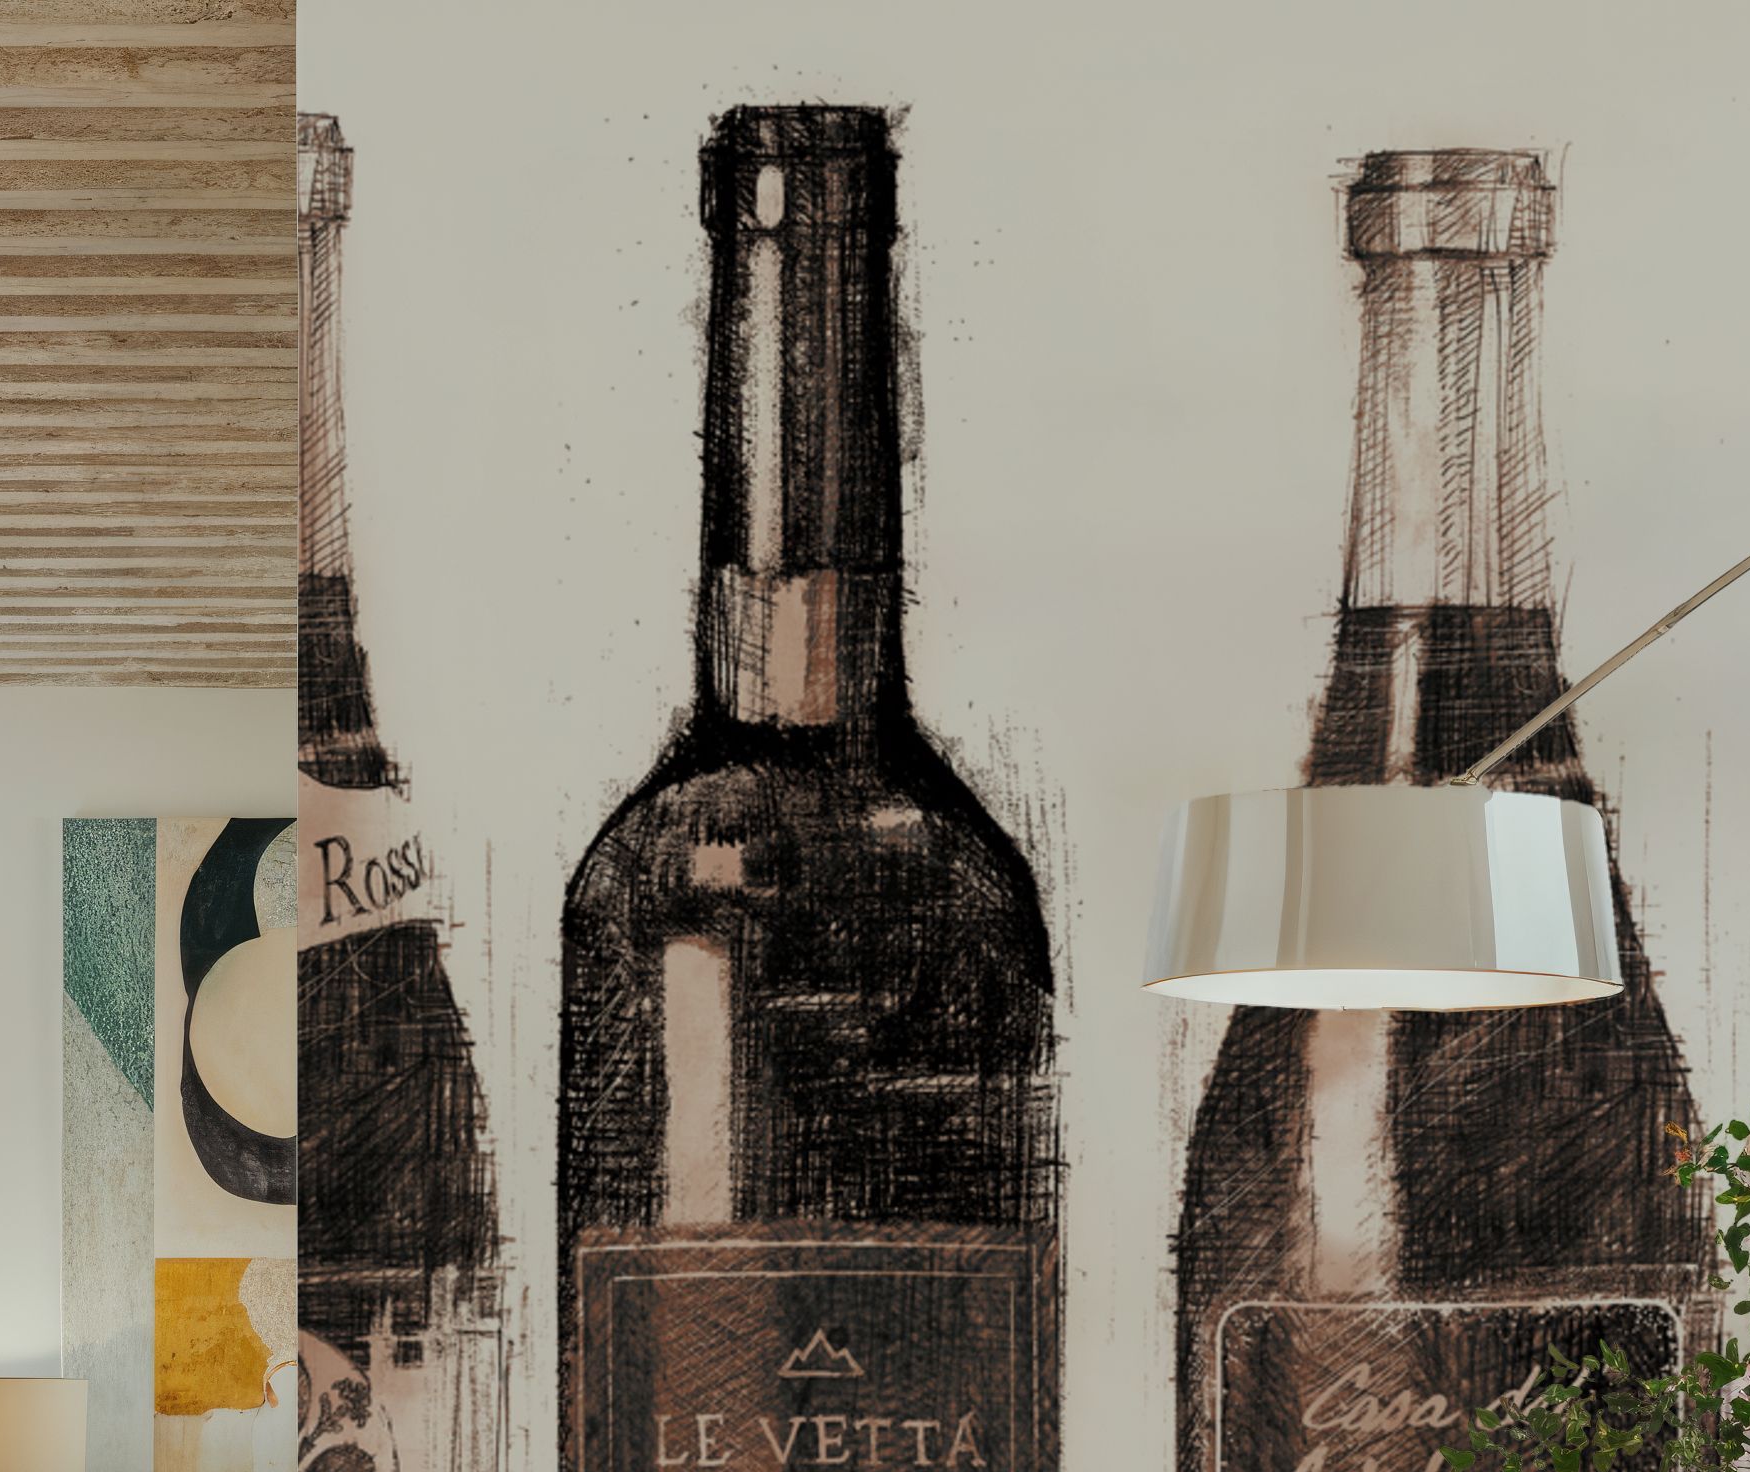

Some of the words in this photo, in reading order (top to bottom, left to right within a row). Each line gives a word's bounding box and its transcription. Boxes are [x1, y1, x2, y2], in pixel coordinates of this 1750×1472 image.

[1302, 1361, 1462, 1431] Casa
[654, 1413, 731, 1467] LE
[758, 1409, 987, 1468] VETTA
